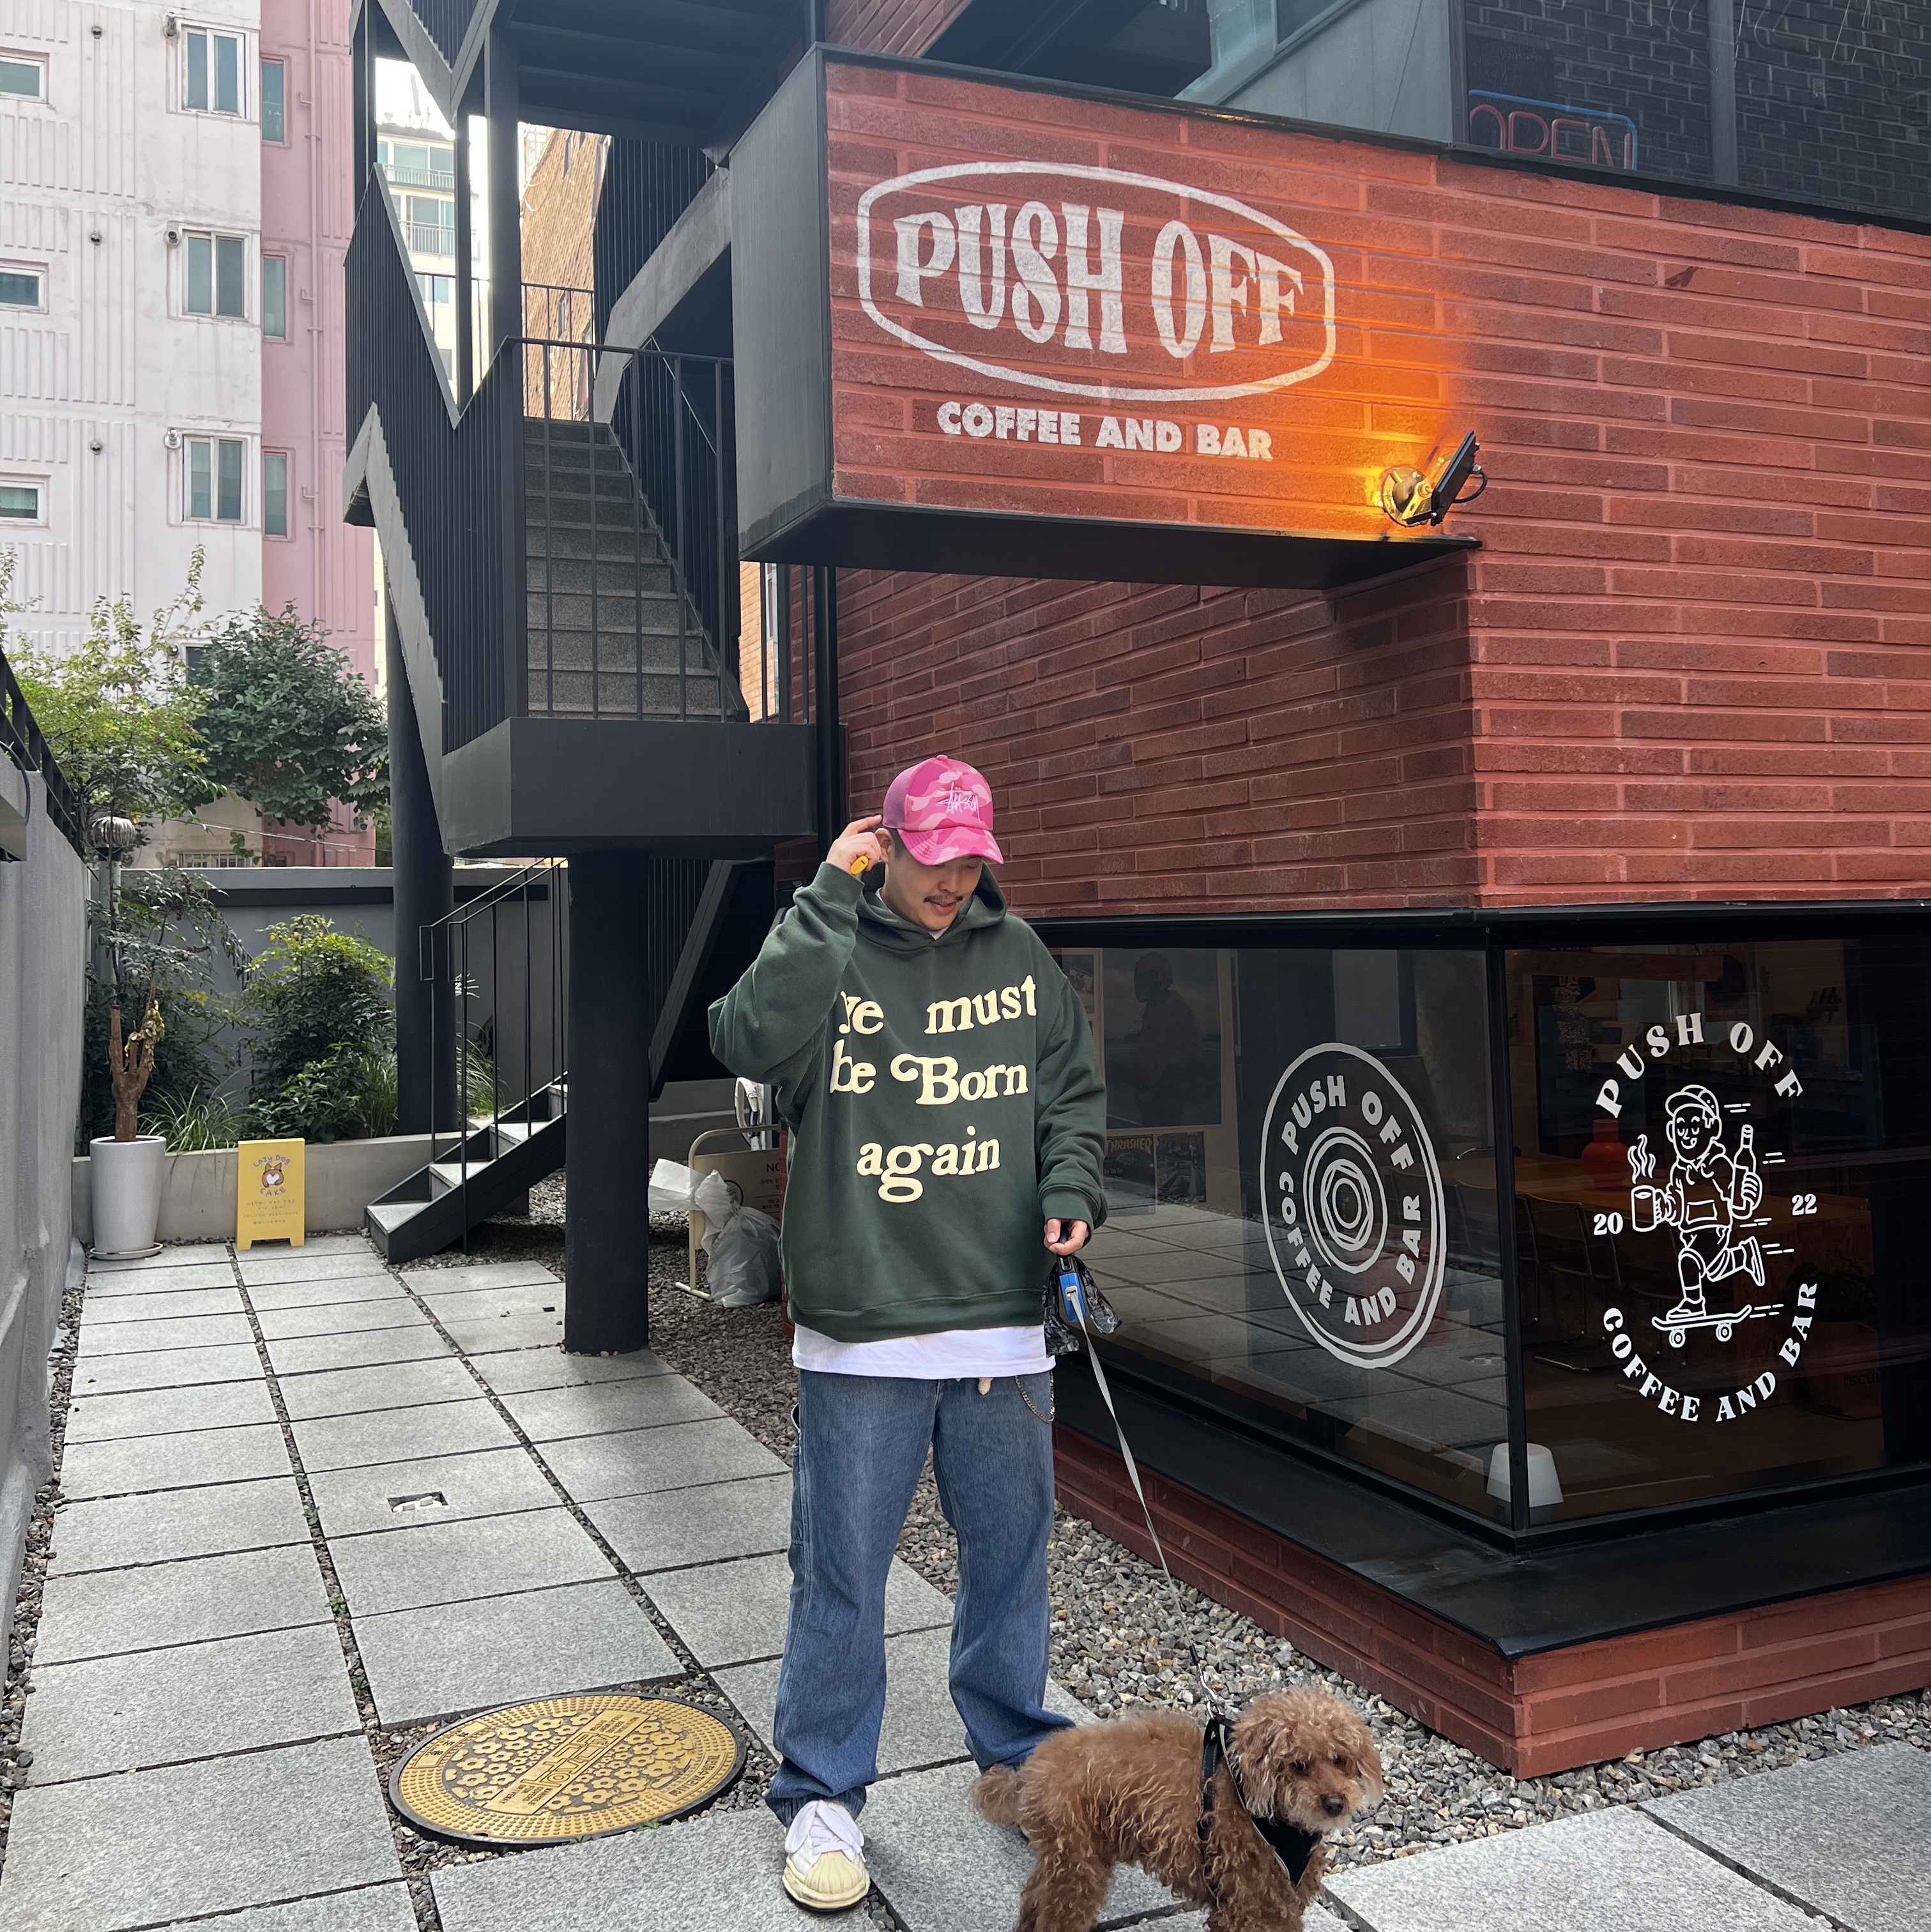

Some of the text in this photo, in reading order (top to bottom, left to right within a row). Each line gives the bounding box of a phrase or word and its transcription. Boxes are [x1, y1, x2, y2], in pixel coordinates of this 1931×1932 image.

[1469, 104, 1632, 169] OPEN
[893, 201, 1304, 358] PUSH OFF
[936, 402, 1273, 460] COFFEE AND BAR
[924, 975, 1037, 1034] must
[829, 1039, 1028, 1105] be Born
[1596, 1012, 1803, 1118] PUSH OFF
[1281, 1075, 1414, 1170] PUSH OFF
[275, 1154, 291, 1166] Dog
[857, 1125, 1000, 1203] again
[1593, 1212, 1624, 1236] 20
[1792, 1193, 1817, 1216] 22
[1279, 1171, 1421, 1326] COFFEE AND BAR
[1603, 1283, 1817, 1422] COFFEE AND BAR
[520, 1731, 621, 1788] 접근주의
